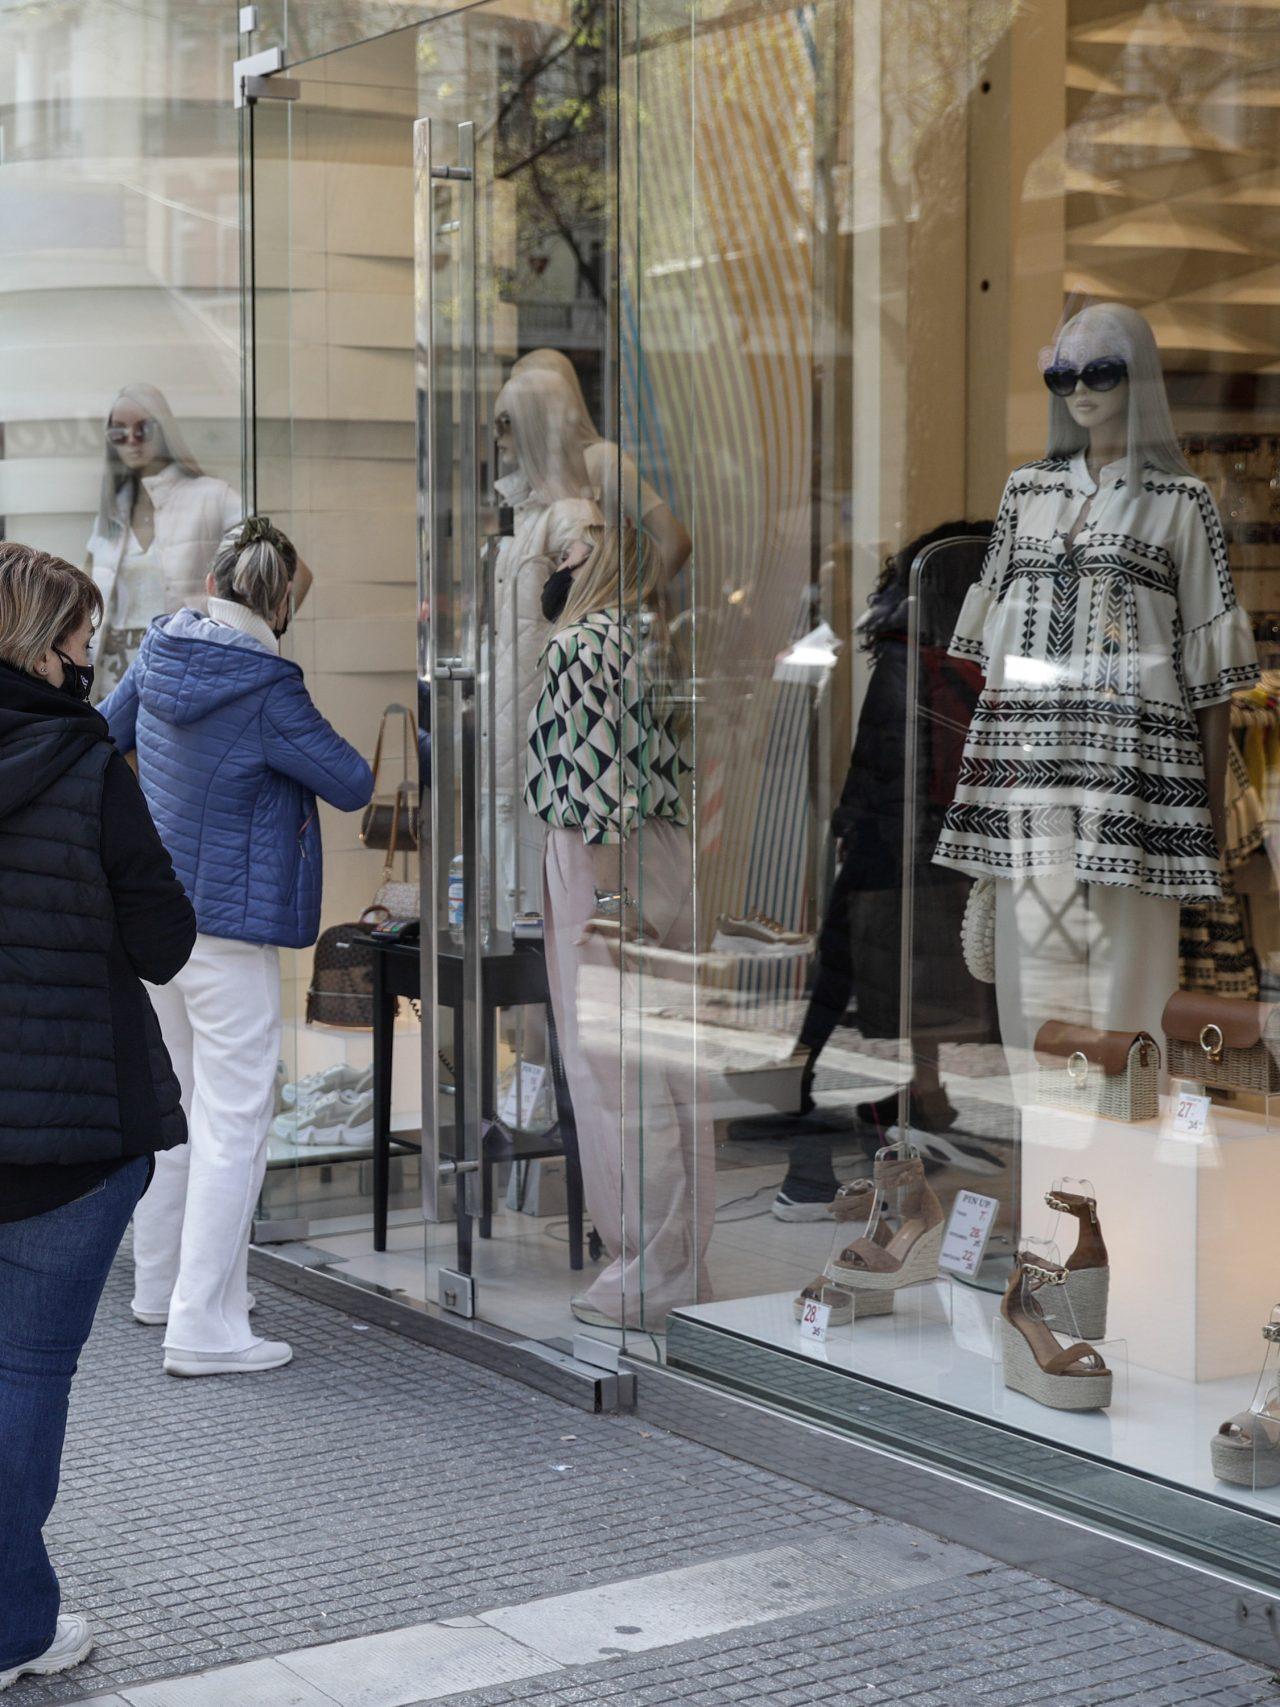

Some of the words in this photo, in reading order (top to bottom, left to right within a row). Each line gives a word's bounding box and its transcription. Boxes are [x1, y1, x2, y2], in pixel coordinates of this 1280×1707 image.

[962, 1194, 978, 1206] PIN
[978, 1198, 991, 1209] UP
[803, 1303, 817, 1324] 28
